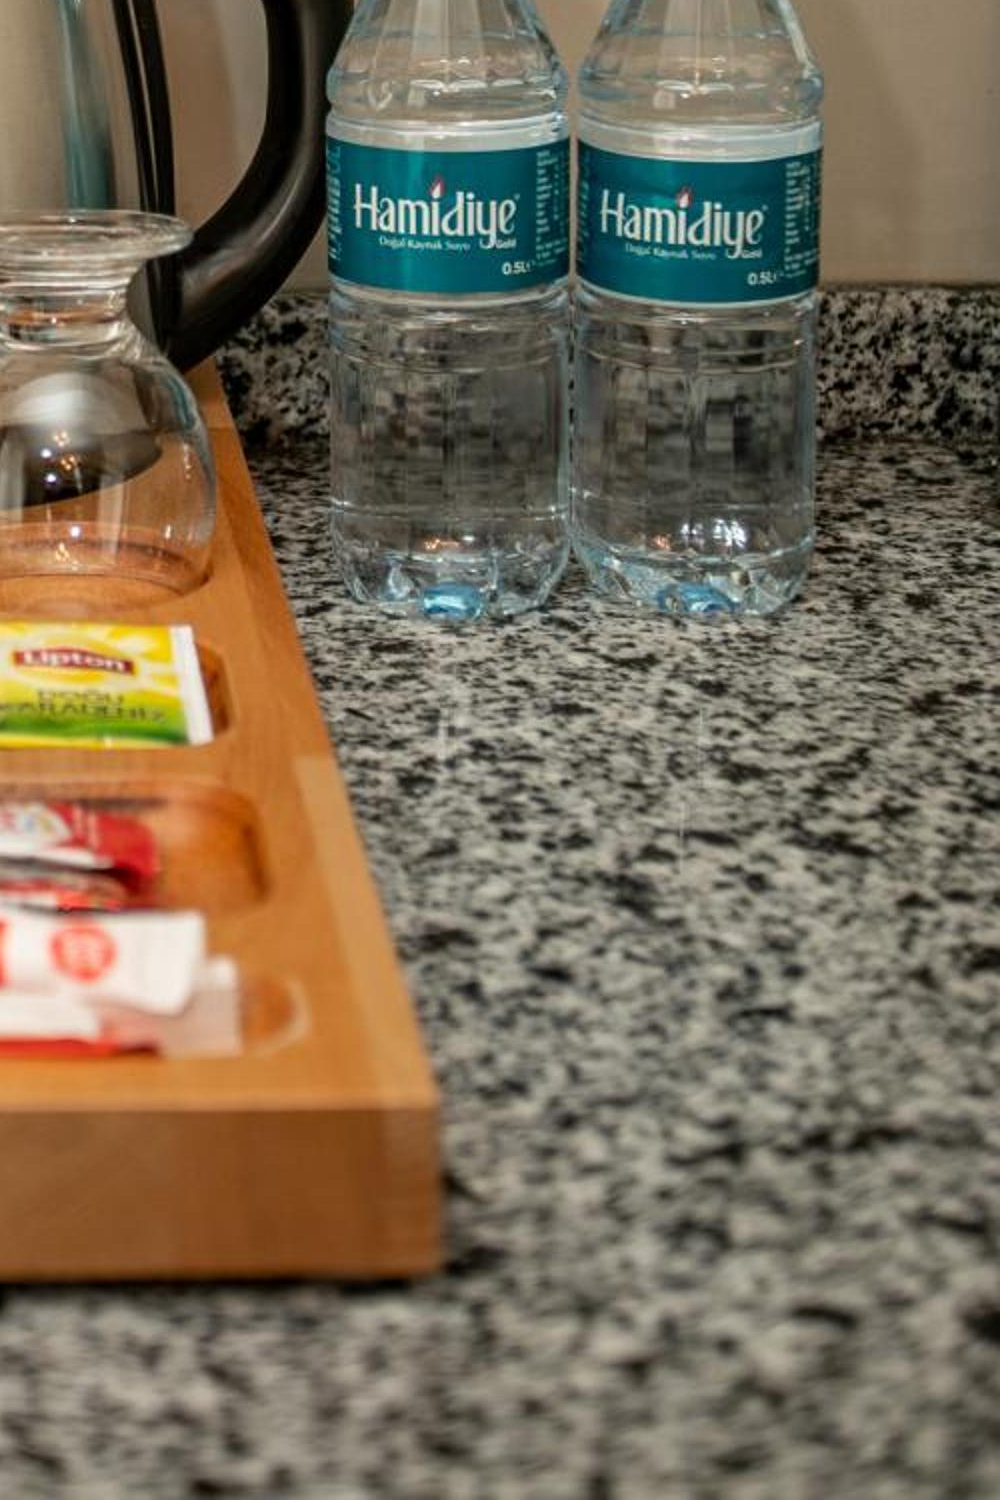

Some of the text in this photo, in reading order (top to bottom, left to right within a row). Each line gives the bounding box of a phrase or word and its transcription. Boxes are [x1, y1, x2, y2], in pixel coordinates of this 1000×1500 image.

[354, 180, 517, 248] Hamidiye
[601, 189, 764, 259] Hamidiye
[22, 649, 126, 673] Lipton
